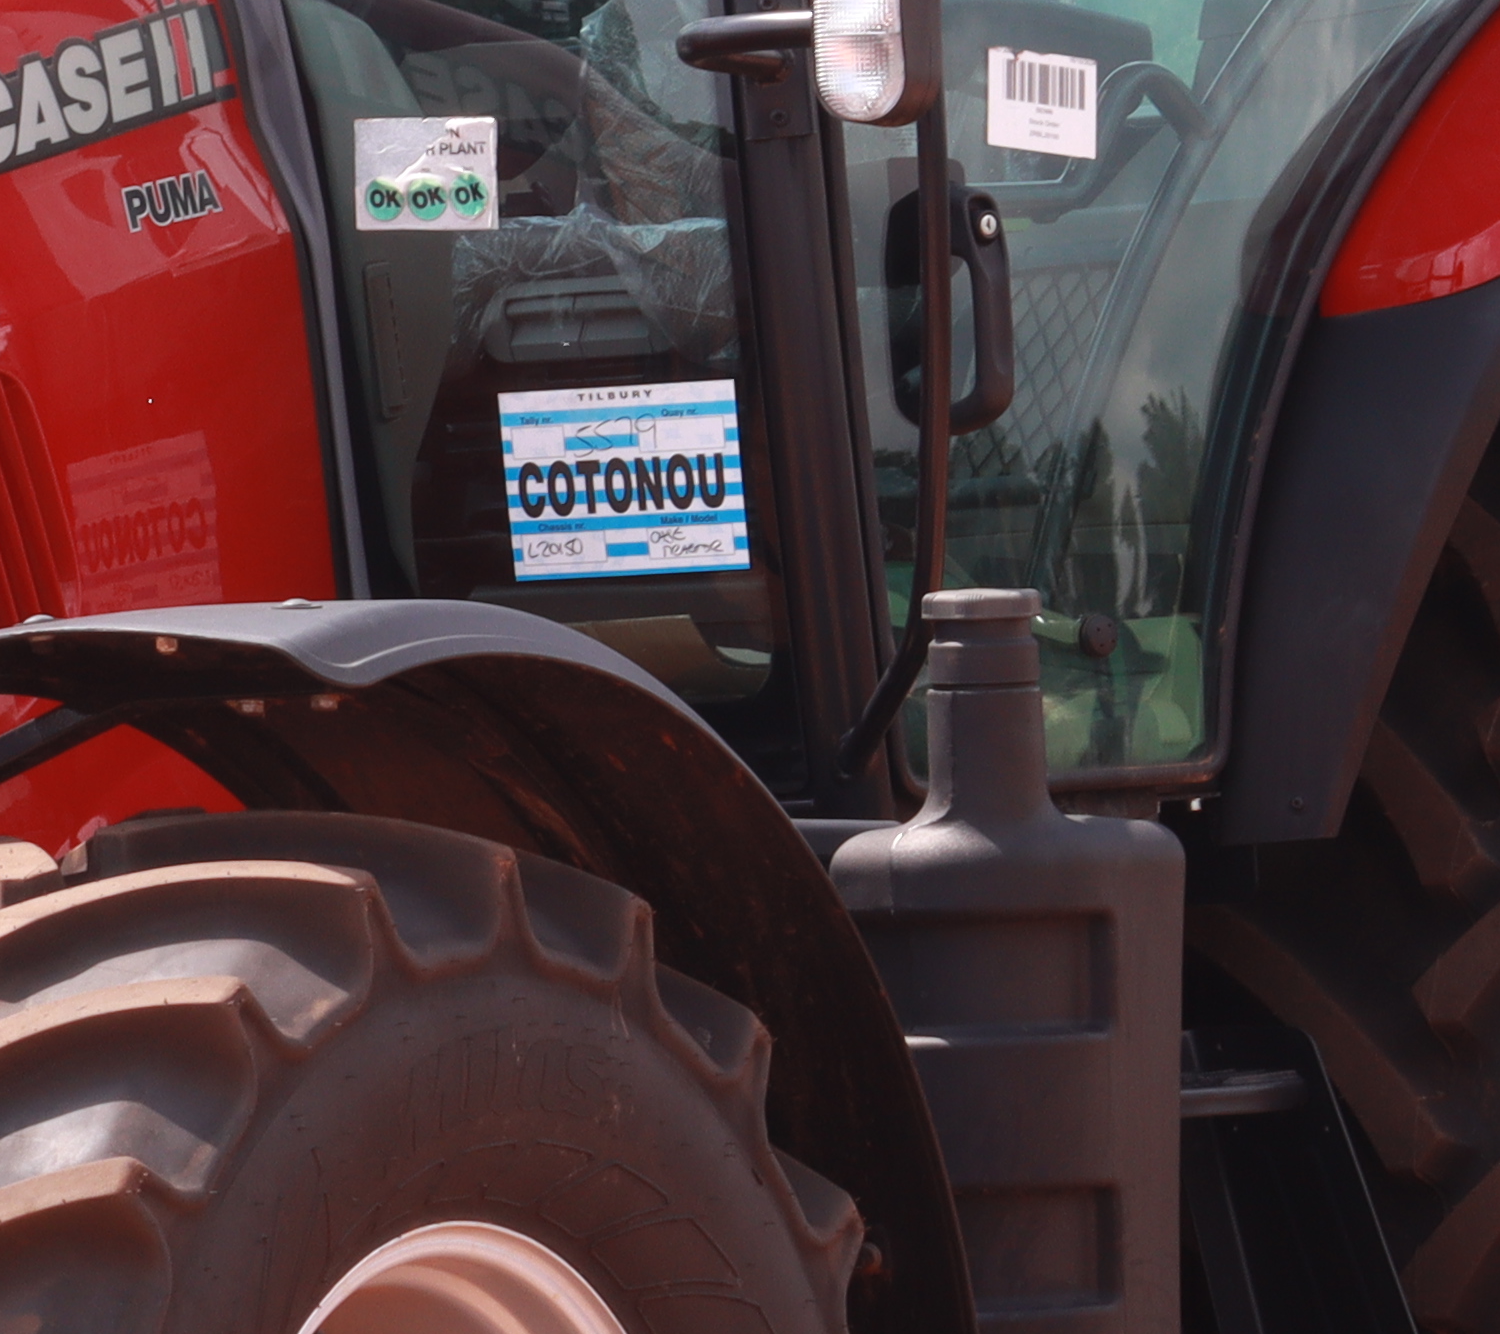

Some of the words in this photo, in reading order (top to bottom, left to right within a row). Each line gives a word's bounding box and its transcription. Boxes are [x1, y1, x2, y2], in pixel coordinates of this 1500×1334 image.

[438, 141, 487, 156] PLANT
[123, 170, 222, 233] PUMA
[370, 188, 402, 208] OK
[411, 186, 446, 209] OK
[454, 182, 486, 205] OK
[576, 388, 654, 402] TILBURY
[518, 453, 726, 519] COTONOU
